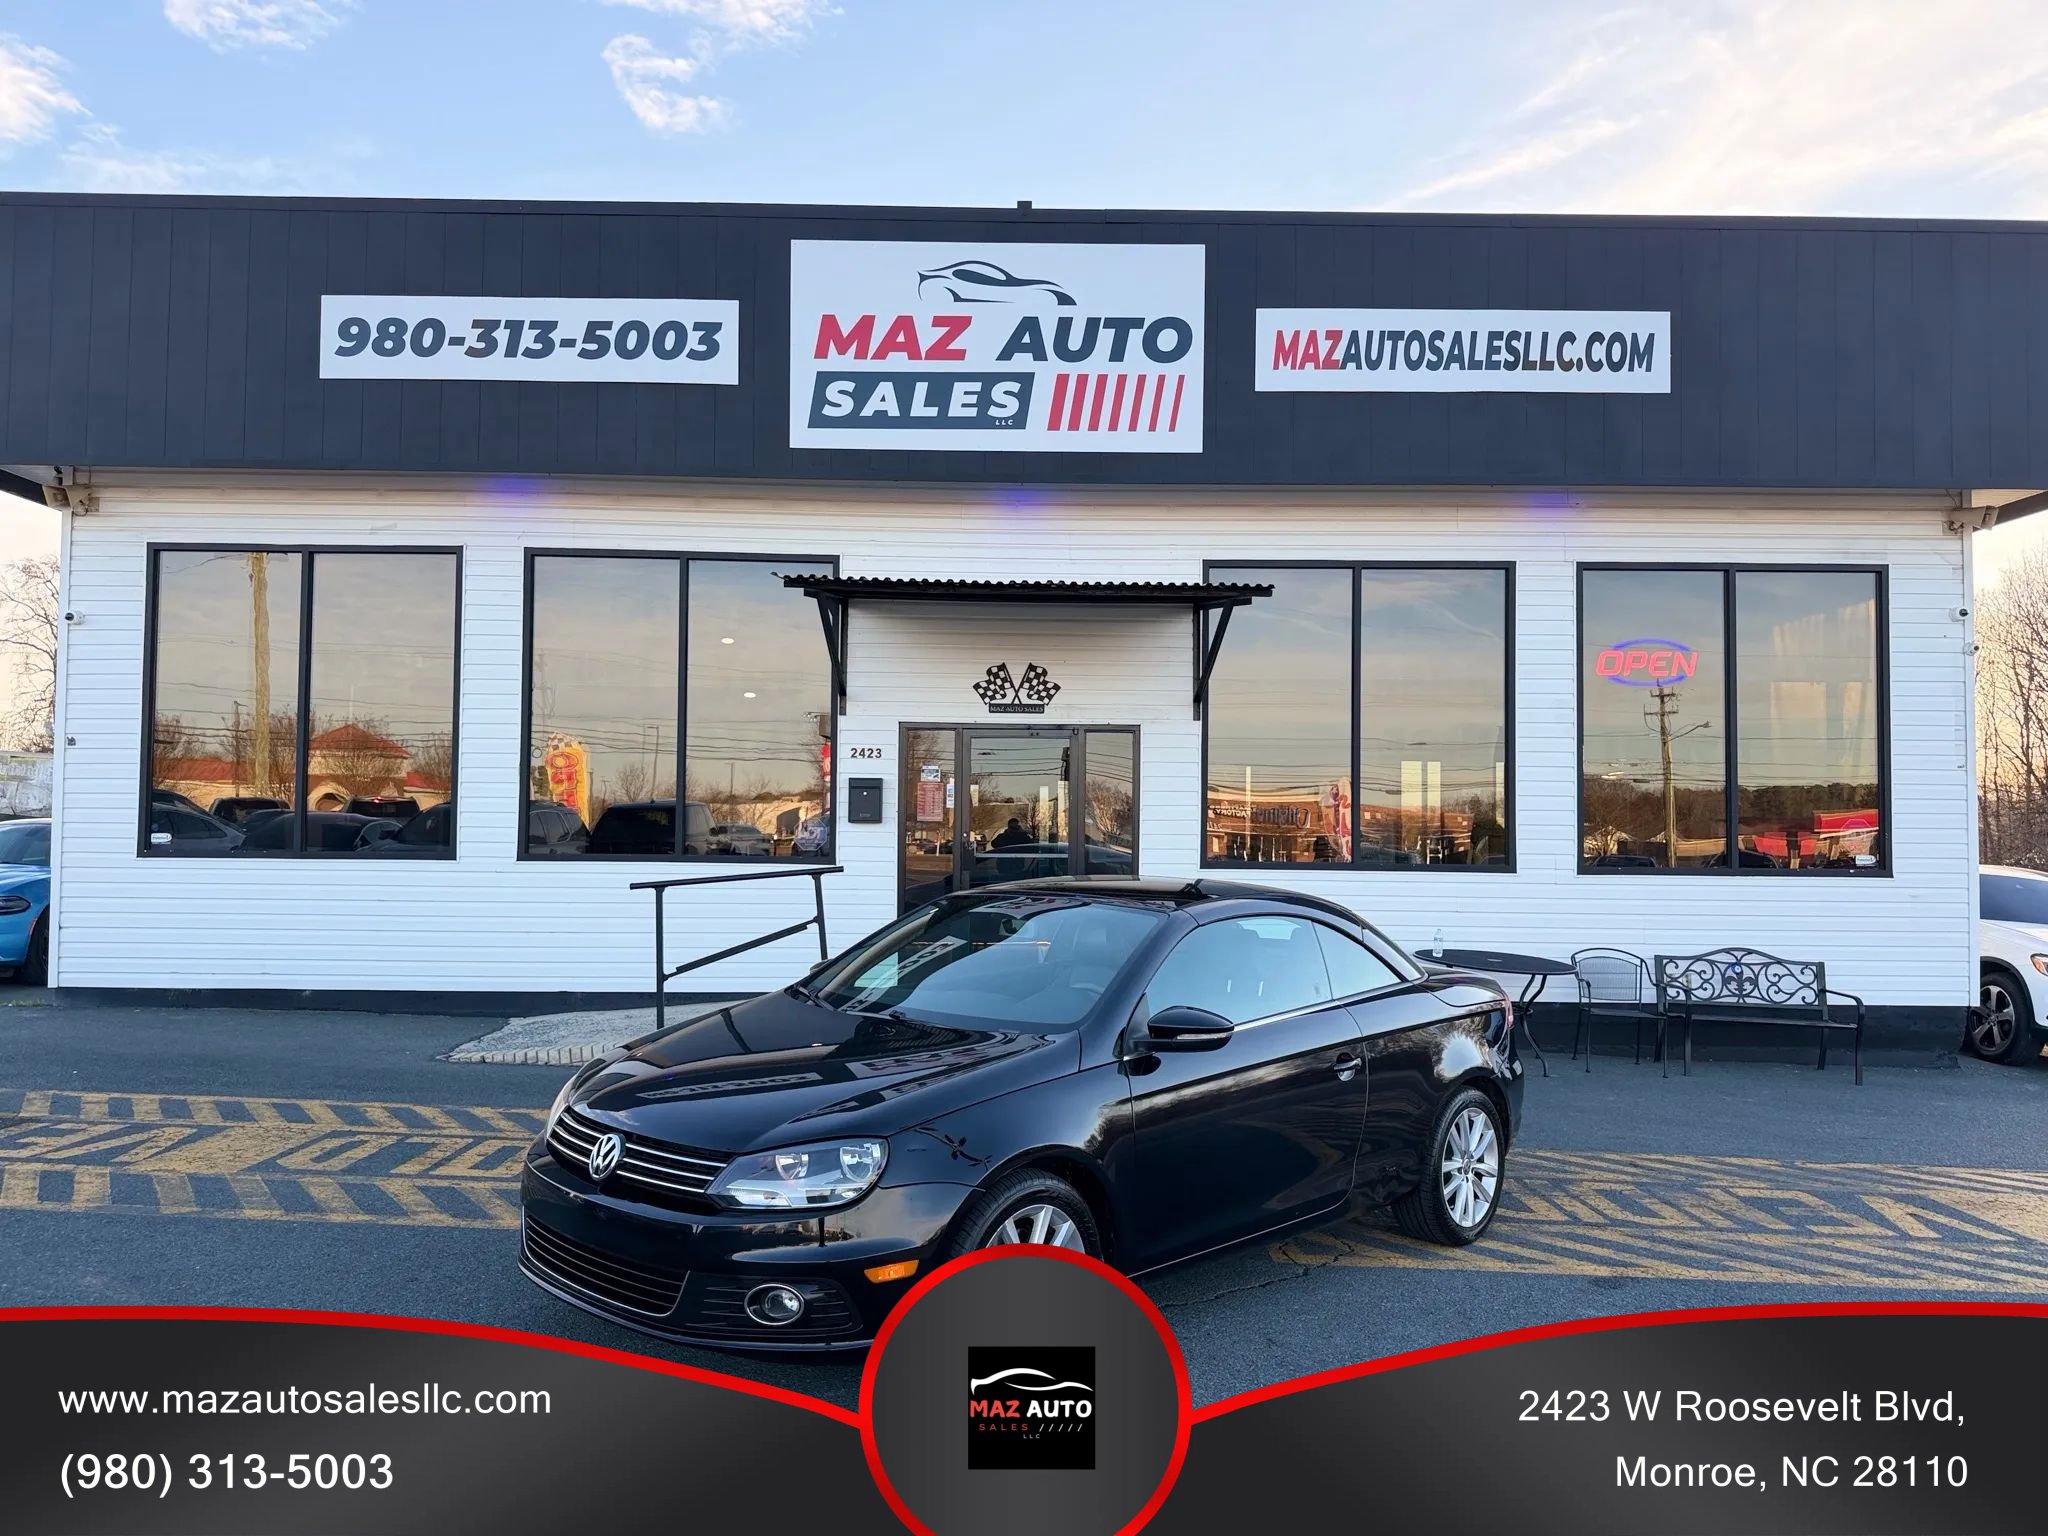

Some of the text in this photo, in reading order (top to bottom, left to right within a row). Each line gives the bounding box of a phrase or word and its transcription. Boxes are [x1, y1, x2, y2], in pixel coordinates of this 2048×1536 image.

[335, 316, 723, 362] 980-313-5003
[814, 314, 1193, 364] MAZ AUTO
[1272, 329, 1656, 373] MAZAUTOSALESLLC.COM
[822, 381, 1022, 418] SALES
[1596, 650, 1698, 678] OPEN
[850, 747, 882, 759] 2423
